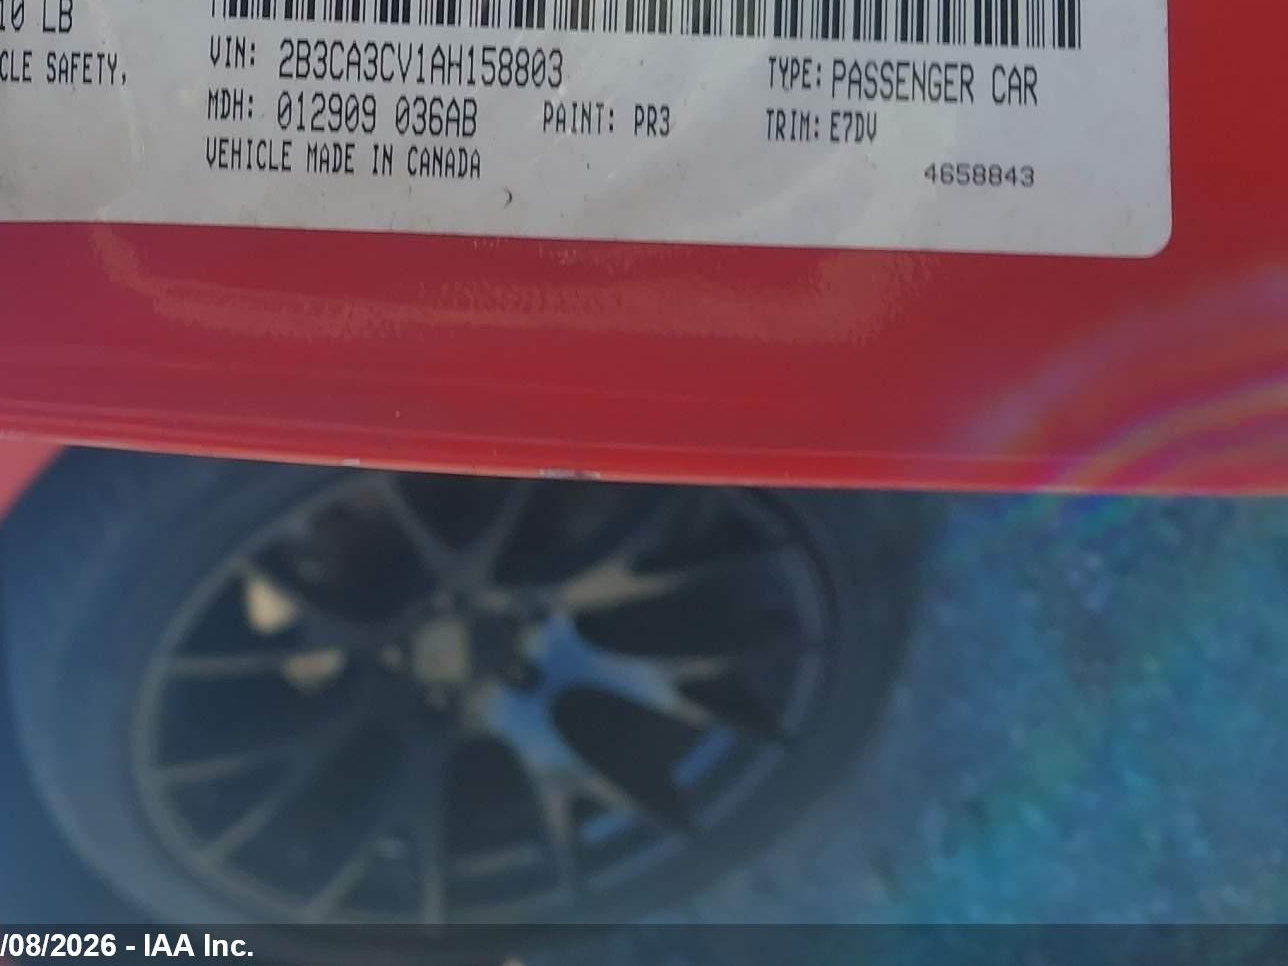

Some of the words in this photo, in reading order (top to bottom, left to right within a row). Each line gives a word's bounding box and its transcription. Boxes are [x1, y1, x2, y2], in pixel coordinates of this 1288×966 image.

[210, 35, 255, 69] VIN:
[279, 38, 563, 89] 2B3CA3CV1AH158803
[769, 56, 821, 91] TYPE:
[832, 58, 974, 104] PASSENGER
[992, 64, 1037, 106] CAR
[208, 88, 253, 121] MDH:
[278, 90, 376, 134] 012909
[395, 95, 477, 138] 036AB
[543, 100, 613, 135] PAINT:
[635, 104, 670, 137] PR3
[766, 108, 819, 141] TRIM:
[830, 110, 876, 143] E7DV
[206, 136, 292, 172] VEHICLE
[307, 142, 355, 174] MADE
[372, 143, 393, 176] IN
[408, 145, 480, 179] CANADA
[924, 163, 1034, 187] 4658843
